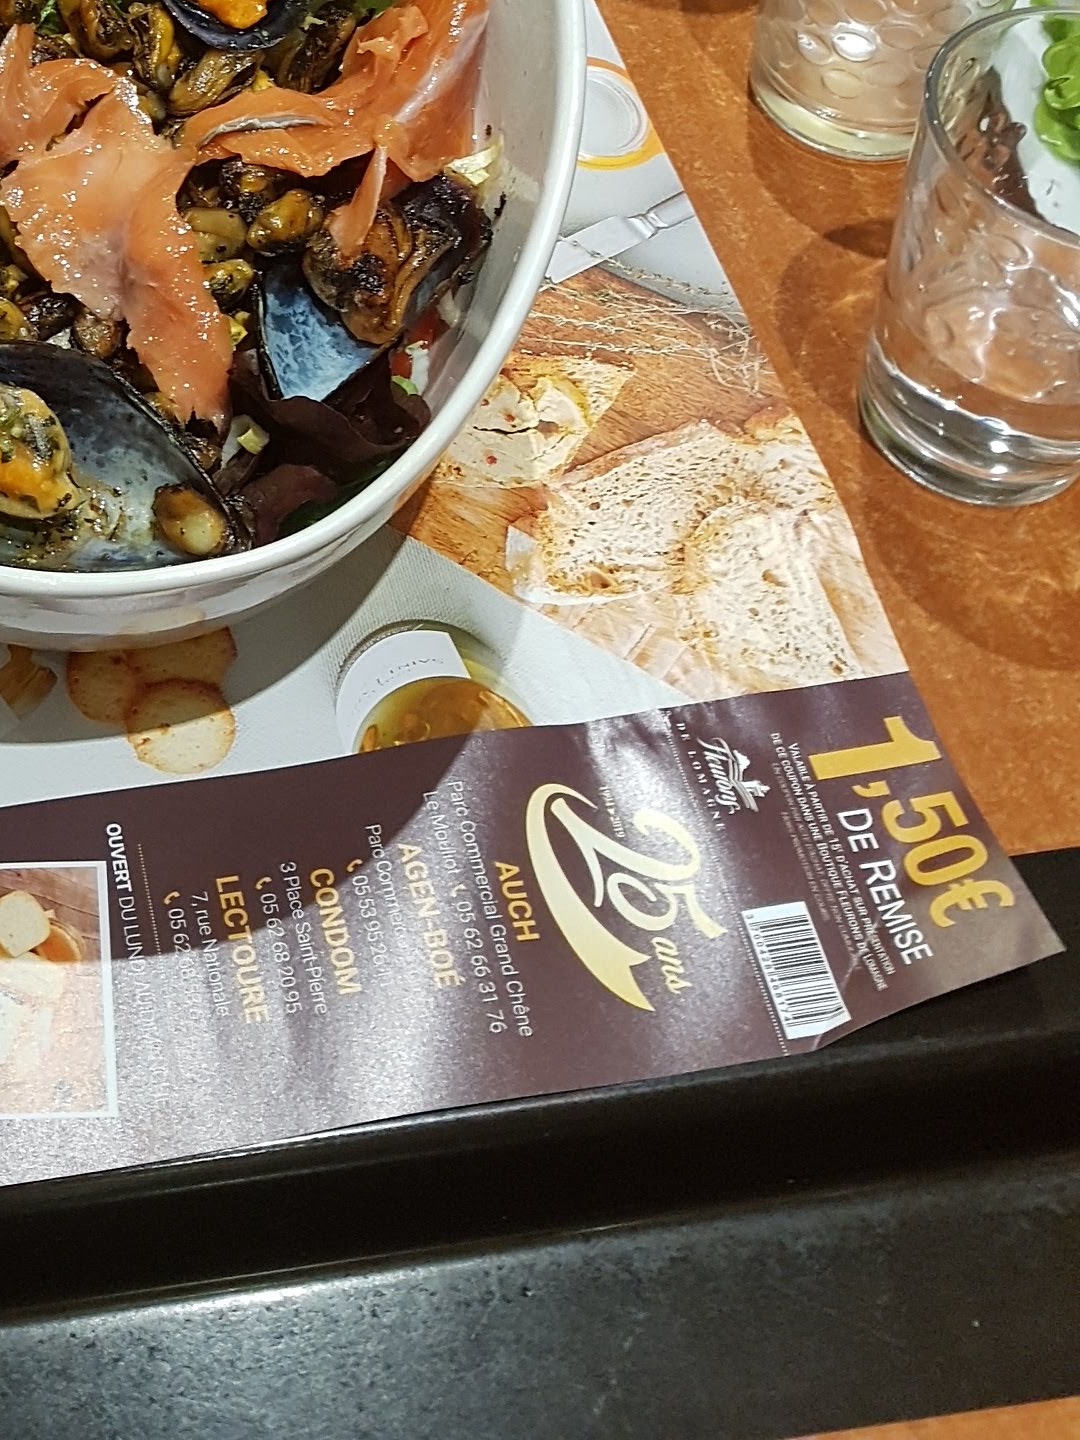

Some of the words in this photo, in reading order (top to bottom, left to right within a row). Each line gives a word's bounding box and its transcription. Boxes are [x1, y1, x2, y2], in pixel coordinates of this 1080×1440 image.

[770, 732, 782, 745] DE
[776, 745, 788, 759] CE
[676, 723, 691, 741] DE
[688, 751, 726, 832] LOMAGNE
[781, 759, 802, 796] COUPON
[423, 791, 440, 811] Le
[795, 796, 814, 822] DANS
[787, 742, 811, 783] VALABLE
[808, 790, 830, 826] PARTIR
[821, 824, 835, 837] DE
[851, 896, 867, 912] SUR
[807, 822, 823, 844] UNE
[808, 716, 1016, 929] 1,50€
[365, 823, 386, 860] Parc
[106, 823, 133, 892] OUVERT
[280, 862, 297, 873] 3
[816, 843, 844, 890] BOUTIQUE
[283, 875, 304, 919] Place
[352, 875, 372, 896] 05
[838, 808, 880, 855] DE
[859, 859, 935, 966] REMISE
[118, 896, 136, 922] DU
[260, 893, 280, 914] 05
[358, 898, 377, 919] 53
[448, 780, 469, 816] Parc
[460, 819, 504, 921] Commercial
[490, 924, 520, 977] Grand
[506, 980, 534, 1039] Chêne
[456, 901, 475, 923] 05
[495, 862, 541, 942] AUCH
[167, 907, 185, 930] 05
[266, 918, 286, 939] 62
[397, 842, 467, 990] AGEN-BOÉ
[834, 890, 864, 942] FLEURONS
[171, 933, 191, 954] 62
[310, 868, 363, 995] CONDOM
[463, 928, 483, 949] 62
[216, 875, 270, 1024] LECTOURE
[273, 941, 291, 963] 68
[193, 910, 211, 935] rue
[202, 939, 230, 1017] Nationale
[295, 922, 327, 1015] Saint-Pierre
[470, 955, 491, 978] 66
[651, 937, 692, 995] ans
[278, 966, 296, 988] 20
[284, 991, 303, 1014] 95
[478, 982, 498, 1003] 31
[487, 1009, 508, 1034] 76
